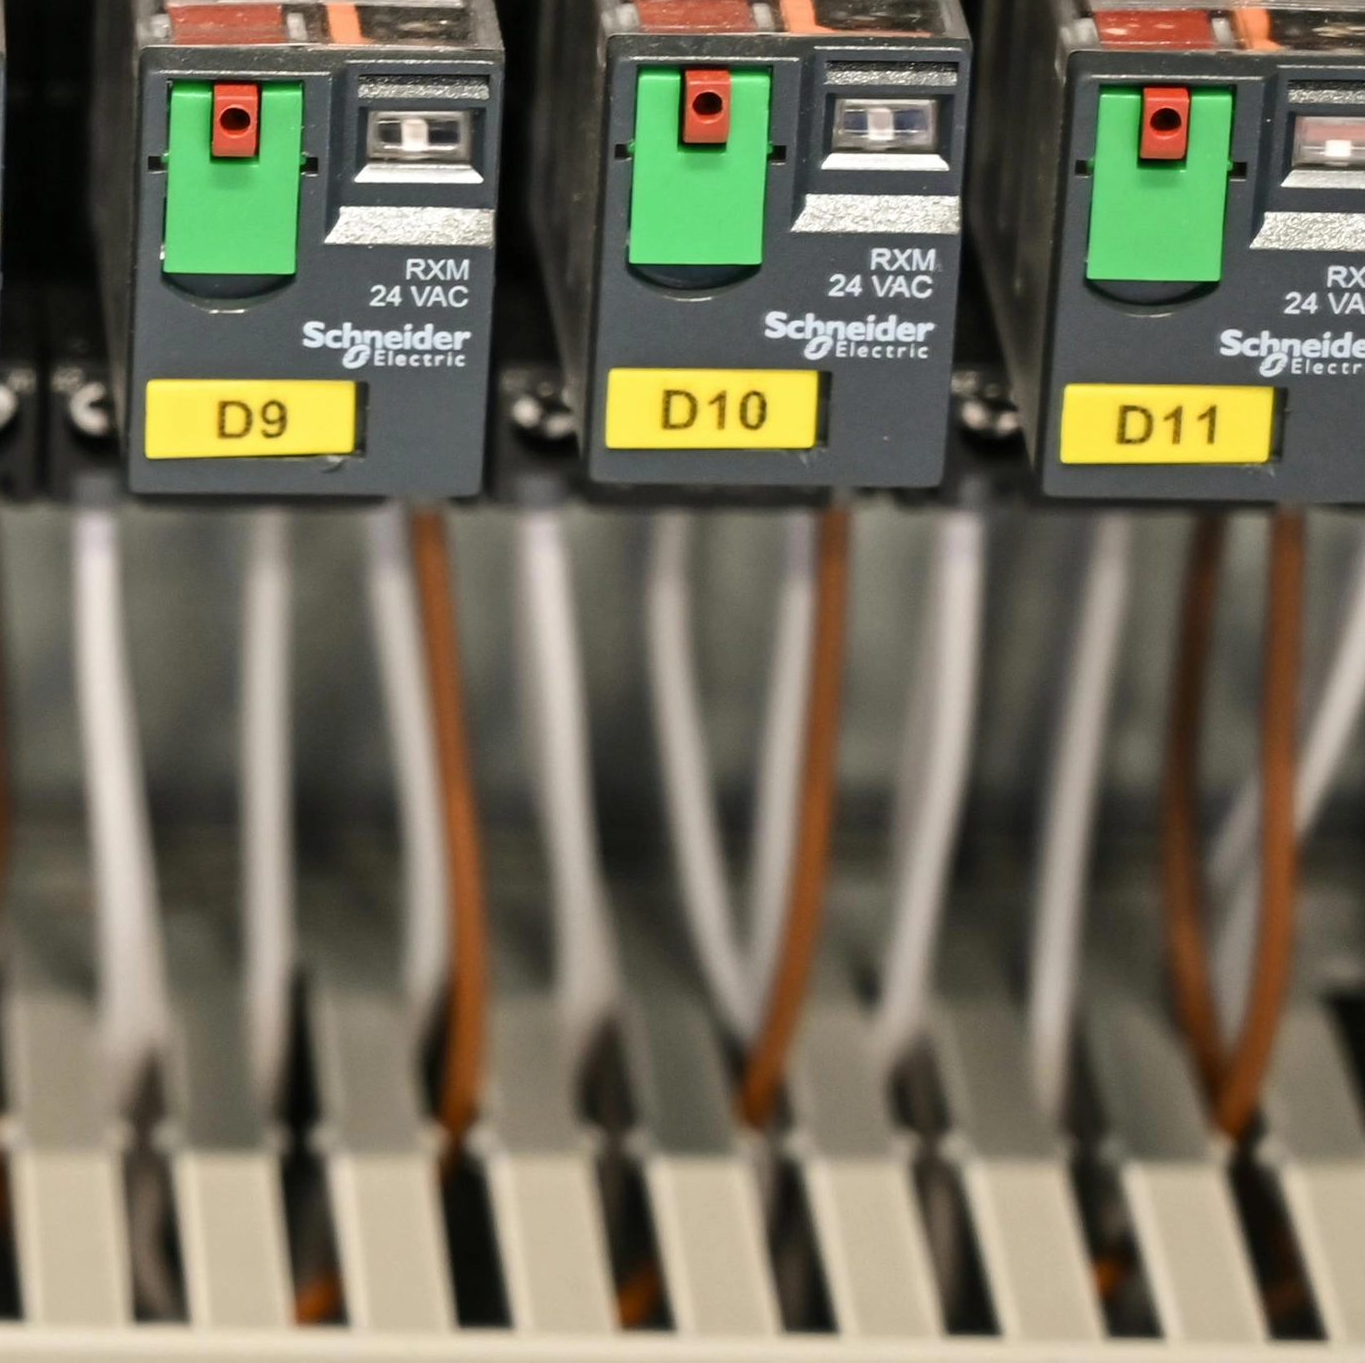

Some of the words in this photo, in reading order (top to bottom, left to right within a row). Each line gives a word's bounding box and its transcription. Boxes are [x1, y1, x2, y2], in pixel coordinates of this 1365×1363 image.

[405, 258, 470, 281] RXM
[870, 247, 936, 272] RXM
[369, 284, 403, 307] 24
[409, 285, 469, 308] VAC
[827, 273, 863, 297] 24
[871, 274, 933, 299] VAC
[1283, 291, 1319, 315] 24
[302, 321, 471, 351] Schneider
[765, 311, 935, 342] Schneider
[374, 351, 465, 366] Electric
[835, 342, 929, 359] Electric
[216, 399, 288, 440] D9
[660, 389, 768, 431] D10
[1115, 404, 1218, 446] D11
